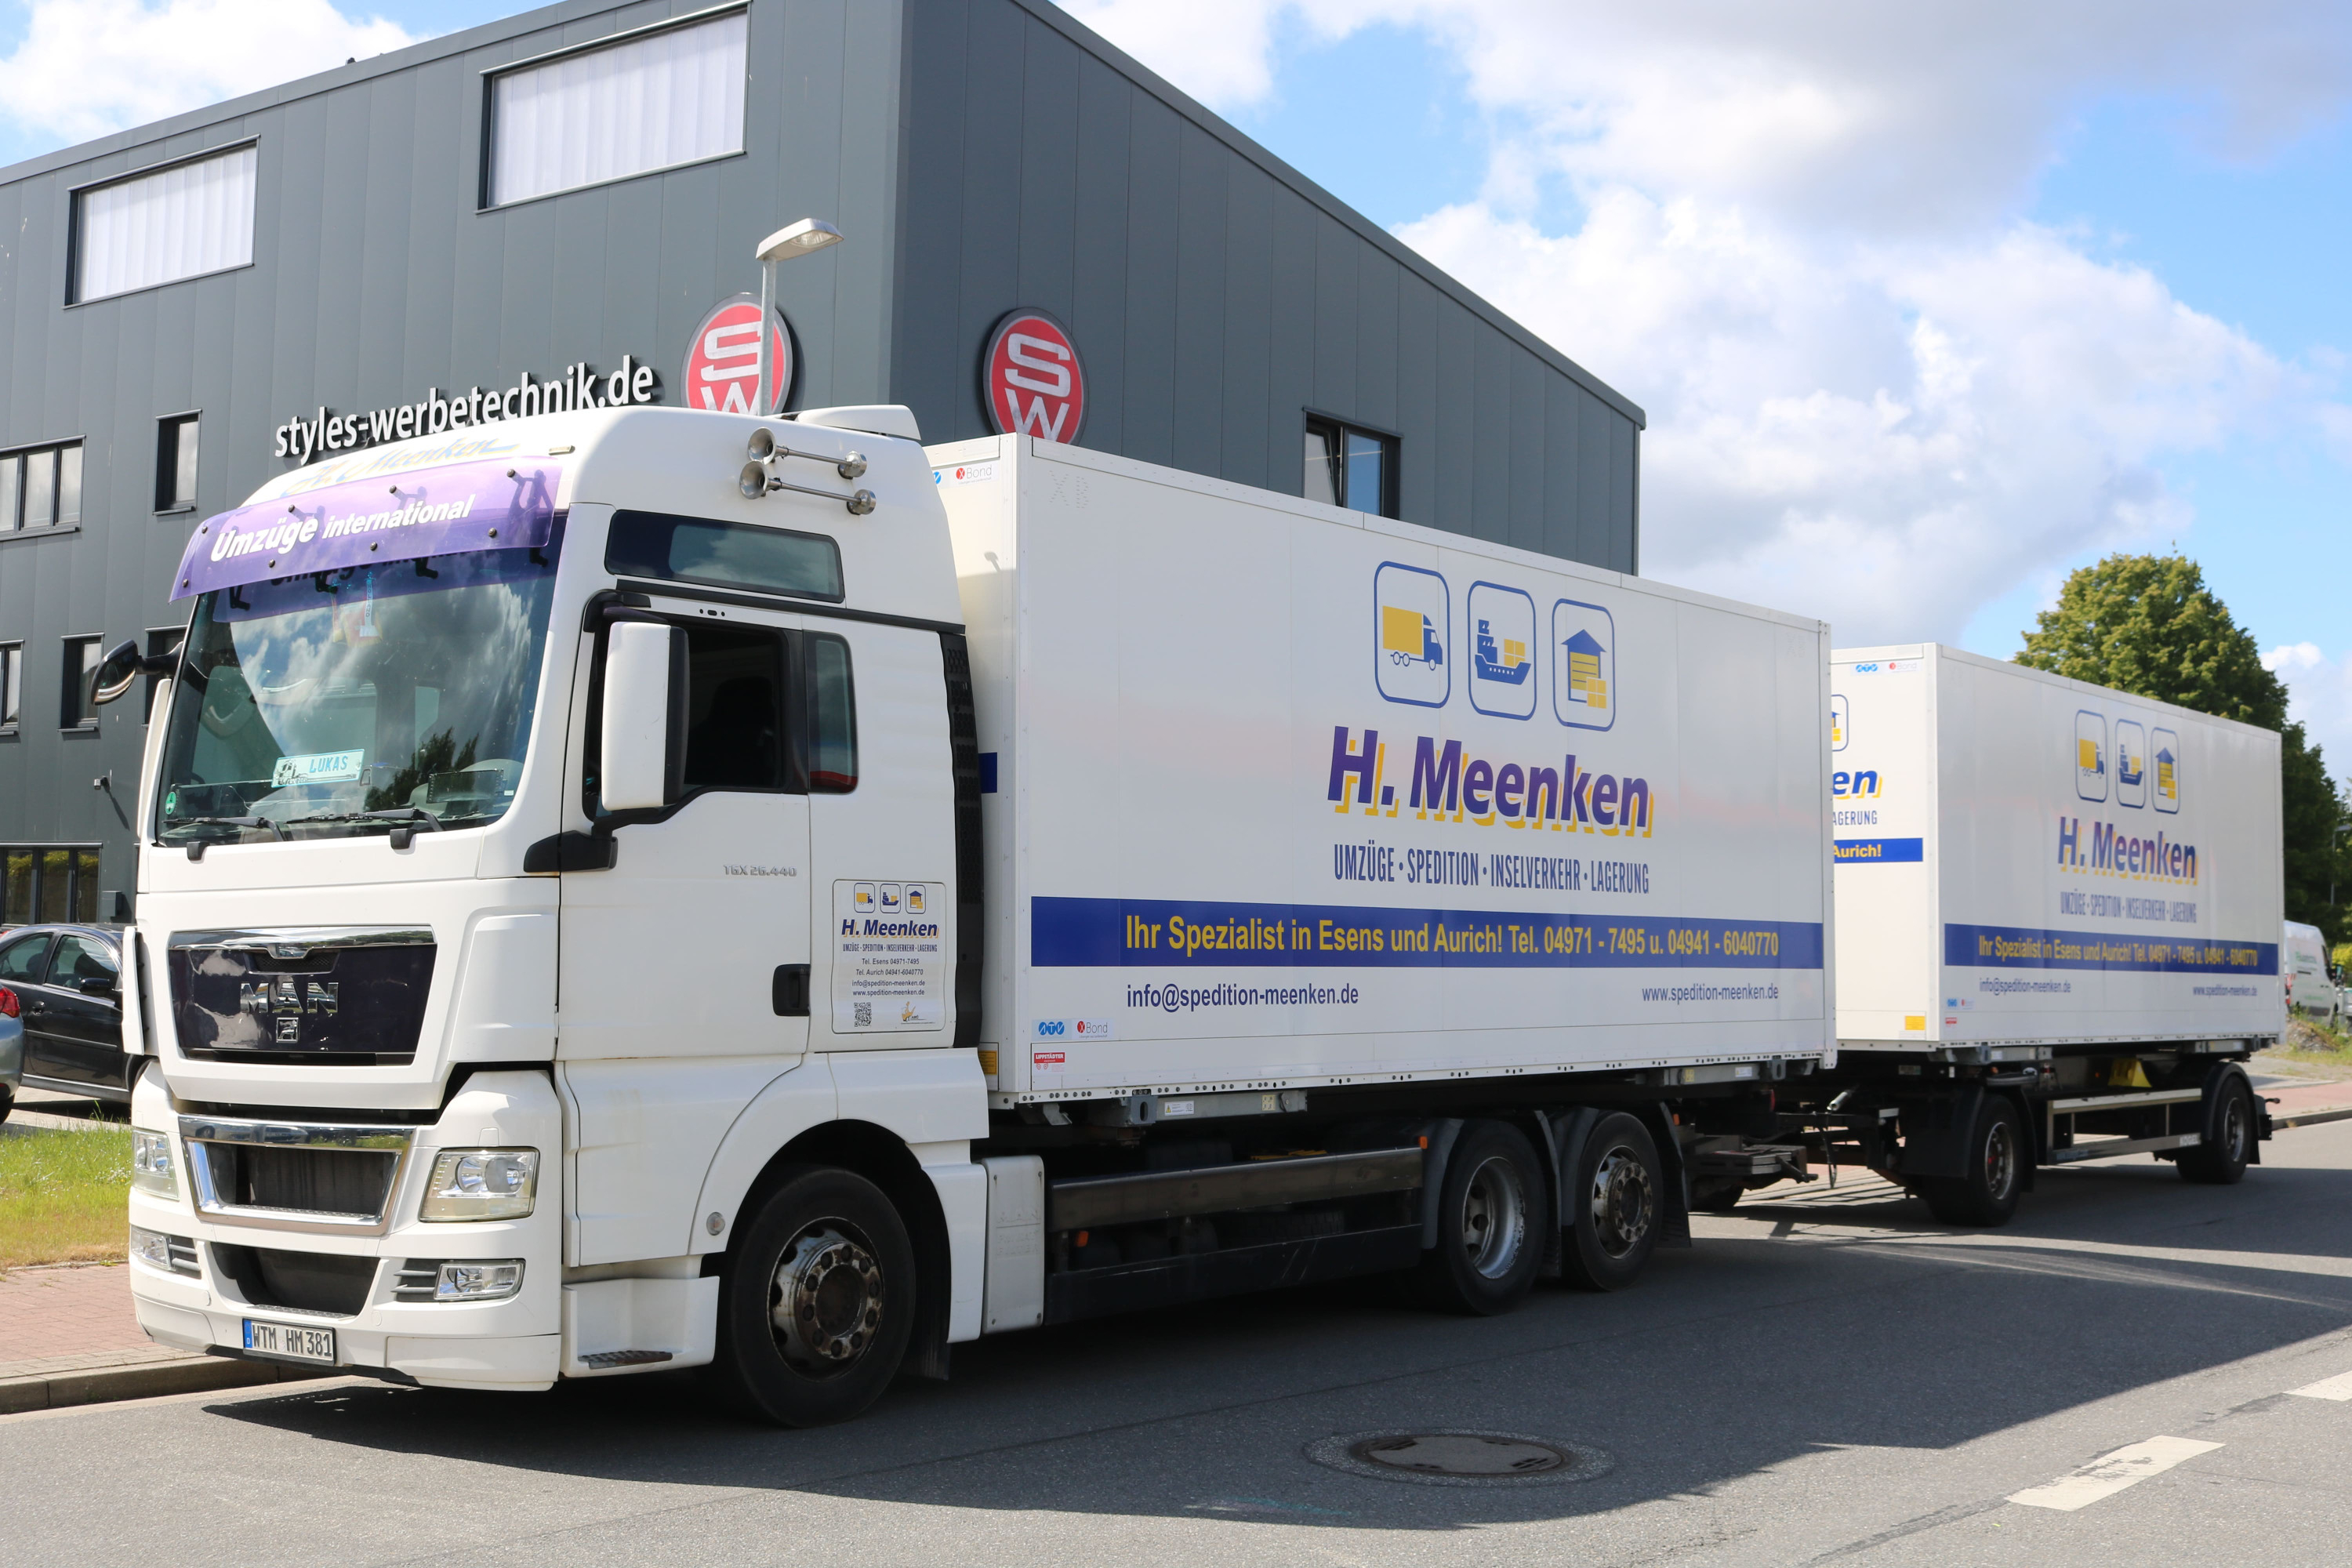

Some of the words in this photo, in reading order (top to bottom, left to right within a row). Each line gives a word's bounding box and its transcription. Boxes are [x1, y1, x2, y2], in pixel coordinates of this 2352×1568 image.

[275, 355, 654, 465] styles-werbetechnik.de
[211, 517, 318, 562] Umzüge
[322, 495, 476, 539] international
[309, 755, 349, 774] LUKAS
[1327, 726, 1399, 818] H.
[1410, 735, 1654, 838] Meenken
[1334, 840, 1396, 883] UMZÜGE
[1407, 848, 1479, 886] SPEDITION
[1490, 854, 1581, 891] INSELVERKEHR
[1591, 860, 1650, 894] LAGERUNG
[2058, 816, 2087, 874] H.
[2092, 821, 2199, 886] Meenken
[723, 865, 748, 876] TGX
[750, 866, 797, 877] 26.440
[841, 919, 861, 938] H.
[863, 919, 939, 938] Meenken
[1126, 915, 1160, 949] Ihr
[1168, 916, 1285, 957] Spezialist
[1291, 920, 1311, 950] in
[1319, 920, 1384, 951] Esens
[1391, 924, 1428, 952] und
[1434, 924, 1502, 953] Aurich!
[1508, 925, 1538, 953] Tel.
[1544, 927, 1592, 954] 04971
[1608, 927, 1646, 954] 7495
[1650, 935, 1664, 955] u.
[1668, 929, 1710, 955] 04941
[1724, 931, 1779, 956] 6040770
[843, 942, 859, 952] UMZÜGE
[1979, 935, 1993, 956] Ihr
[1995, 936, 2042, 962] Spezialist
[2043, 939, 2052, 958] in
[2054, 939, 2081, 959] Esens
[2083, 942, 2100, 960] und
[2102, 942, 2132, 961] Aurich!
[2133, 943, 2147, 962] Tel.
[240, 982, 339, 1014] MAN
[1127, 983, 1359, 1012] info@spedition-meenken.de
[1642, 983, 1779, 1004] www.spedition-meenken.de
[252, 1324, 278, 1350] WTM
[286, 1329, 303, 1354] HM
[306, 1331, 332, 1357] 381
